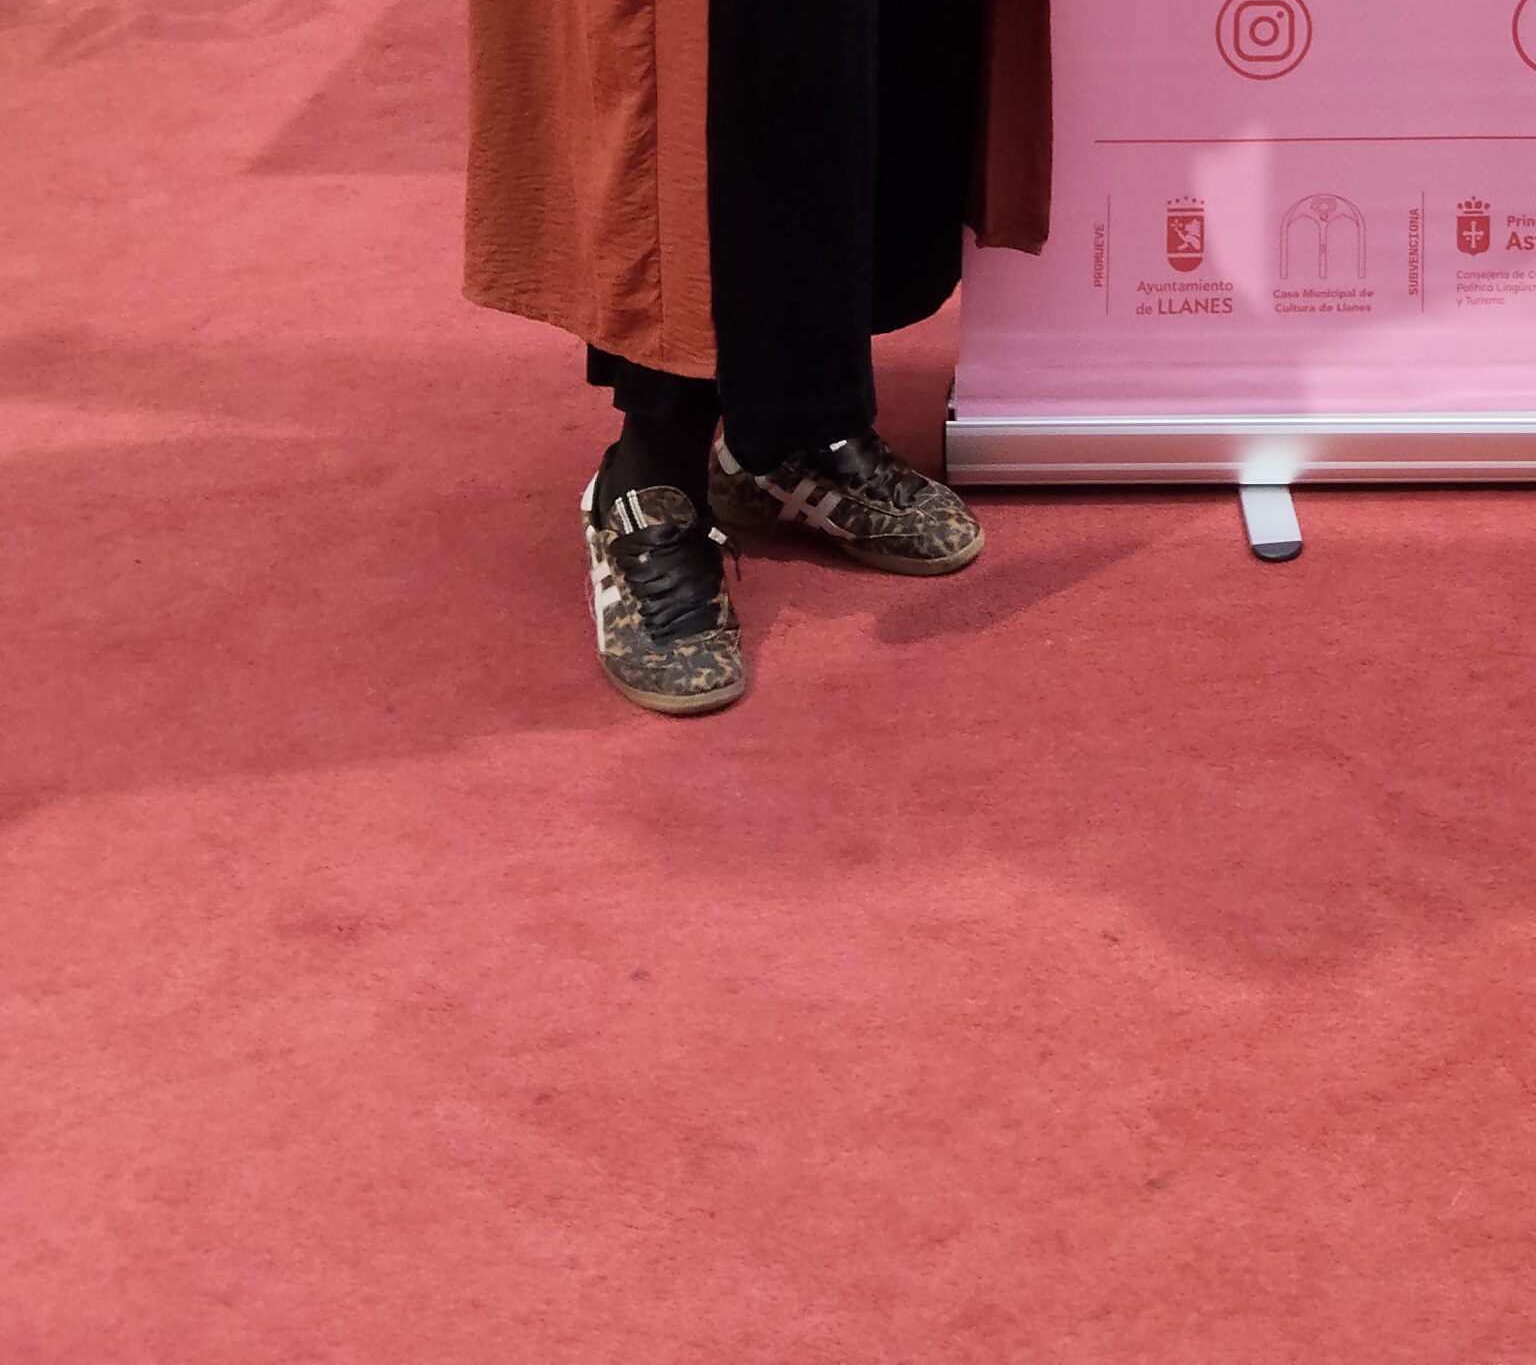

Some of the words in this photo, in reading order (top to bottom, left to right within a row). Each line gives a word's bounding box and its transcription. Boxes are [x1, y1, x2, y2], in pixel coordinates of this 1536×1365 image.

[1093, 223, 1105, 288] PROMUEVE
[1408, 207, 1420, 296] SUBVENCIONA
[1512, 270, 1526, 280] de
[1137, 279, 1234, 296] Ayuntamiento
[1273, 289, 1300, 299] Casa
[1302, 287, 1357, 300] Municipal
[1359, 288, 1374, 299] de
[1135, 302, 1154, 316] de
[1157, 297, 1234, 316] LLANES
[1274, 302, 1317, 313] Cultura
[1319, 302, 1334, 313] de
[1336, 302, 1373, 313] Llanes
[1465, 296, 1506, 306] Turismo
